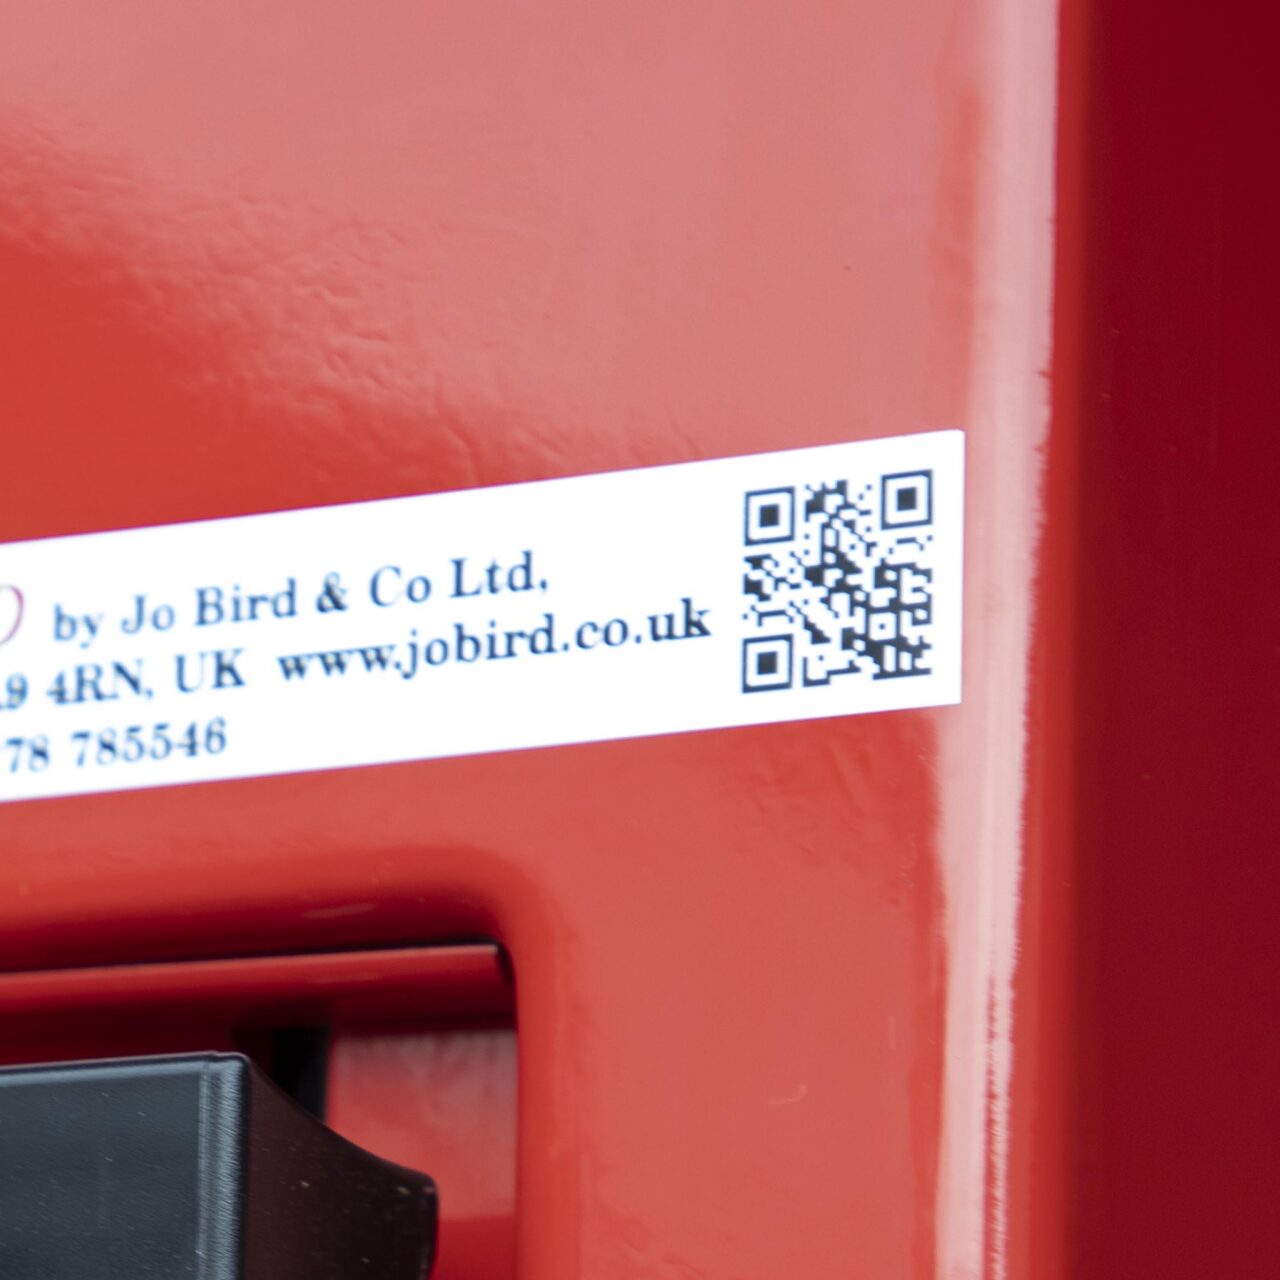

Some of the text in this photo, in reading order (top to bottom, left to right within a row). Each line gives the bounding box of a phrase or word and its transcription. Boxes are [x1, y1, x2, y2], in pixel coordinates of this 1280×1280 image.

[53, 603, 104, 648] by
[120, 594, 175, 633] Jo
[194, 580, 298, 625] Bird
[316, 573, 348, 614] &
[368, 564, 432, 608] Co
[46, 659, 154, 704] 4RN,
[175, 648, 246, 692] UK
[278, 598, 713, 679] www.jobird.co.uk
[71, 717, 227, 766] 785546
